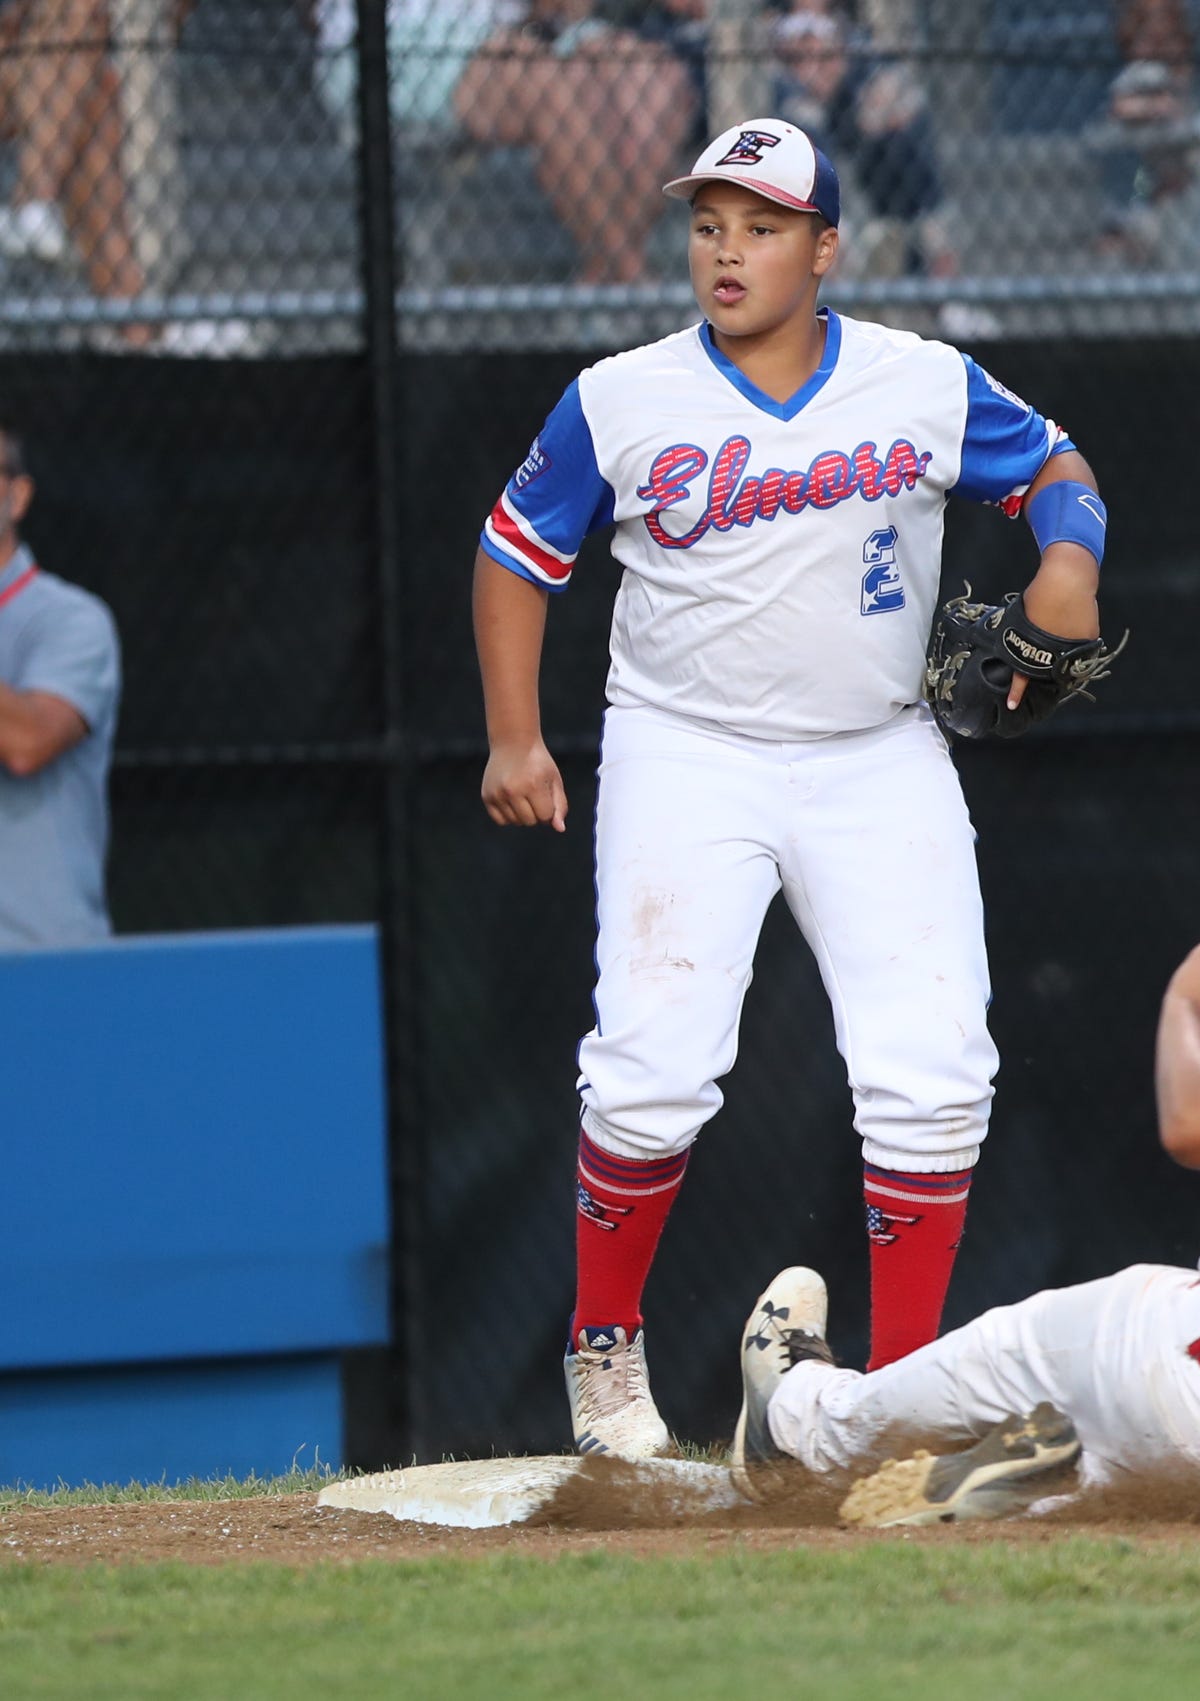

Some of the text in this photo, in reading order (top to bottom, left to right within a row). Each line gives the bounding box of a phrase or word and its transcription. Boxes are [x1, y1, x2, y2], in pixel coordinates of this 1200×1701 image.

[715, 131, 782, 167] E
[637, 434, 932, 549] Elmora
[861, 525, 905, 616] 2
[1006, 630, 1053, 665] Wilson
